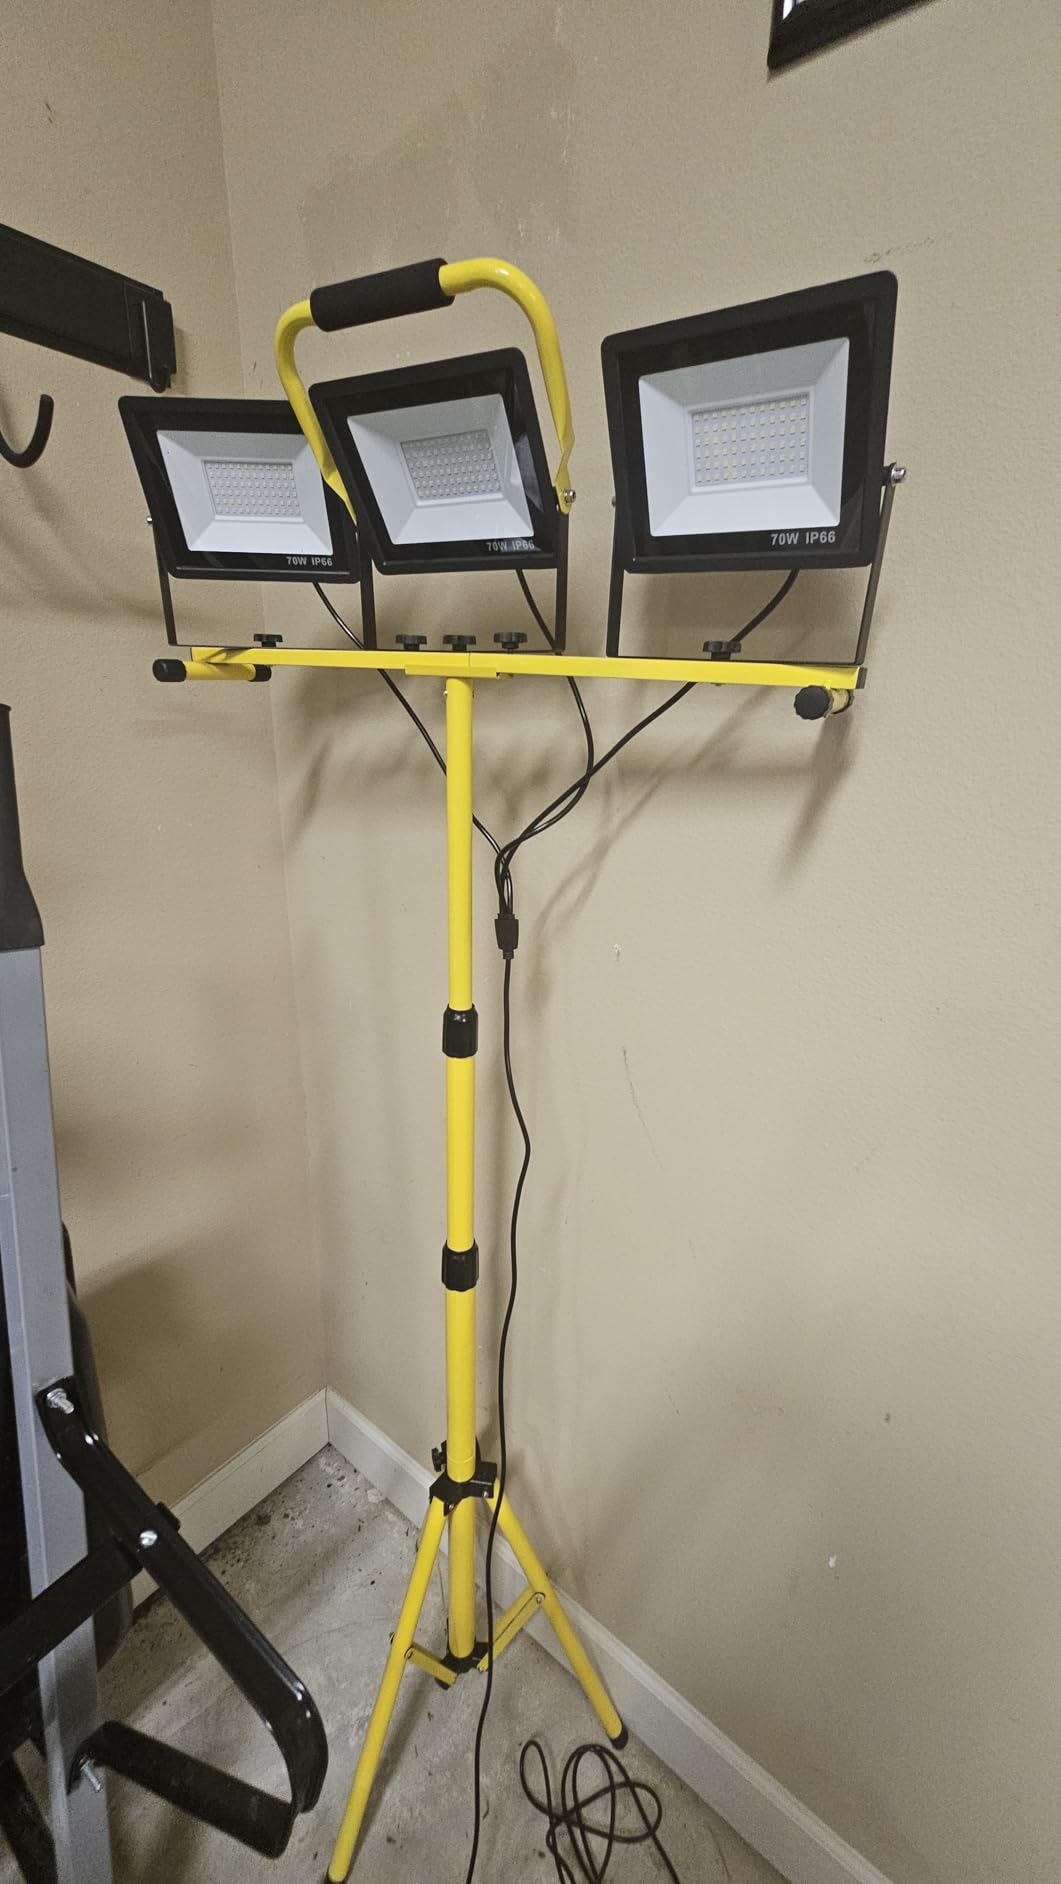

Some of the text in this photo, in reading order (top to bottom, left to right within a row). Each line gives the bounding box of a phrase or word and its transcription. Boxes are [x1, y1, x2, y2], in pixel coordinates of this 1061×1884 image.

[770, 530, 836, 546] 70W IP66
[485, 539, 535, 552] 70W IP66
[285, 556, 333, 567] 70W IP66
